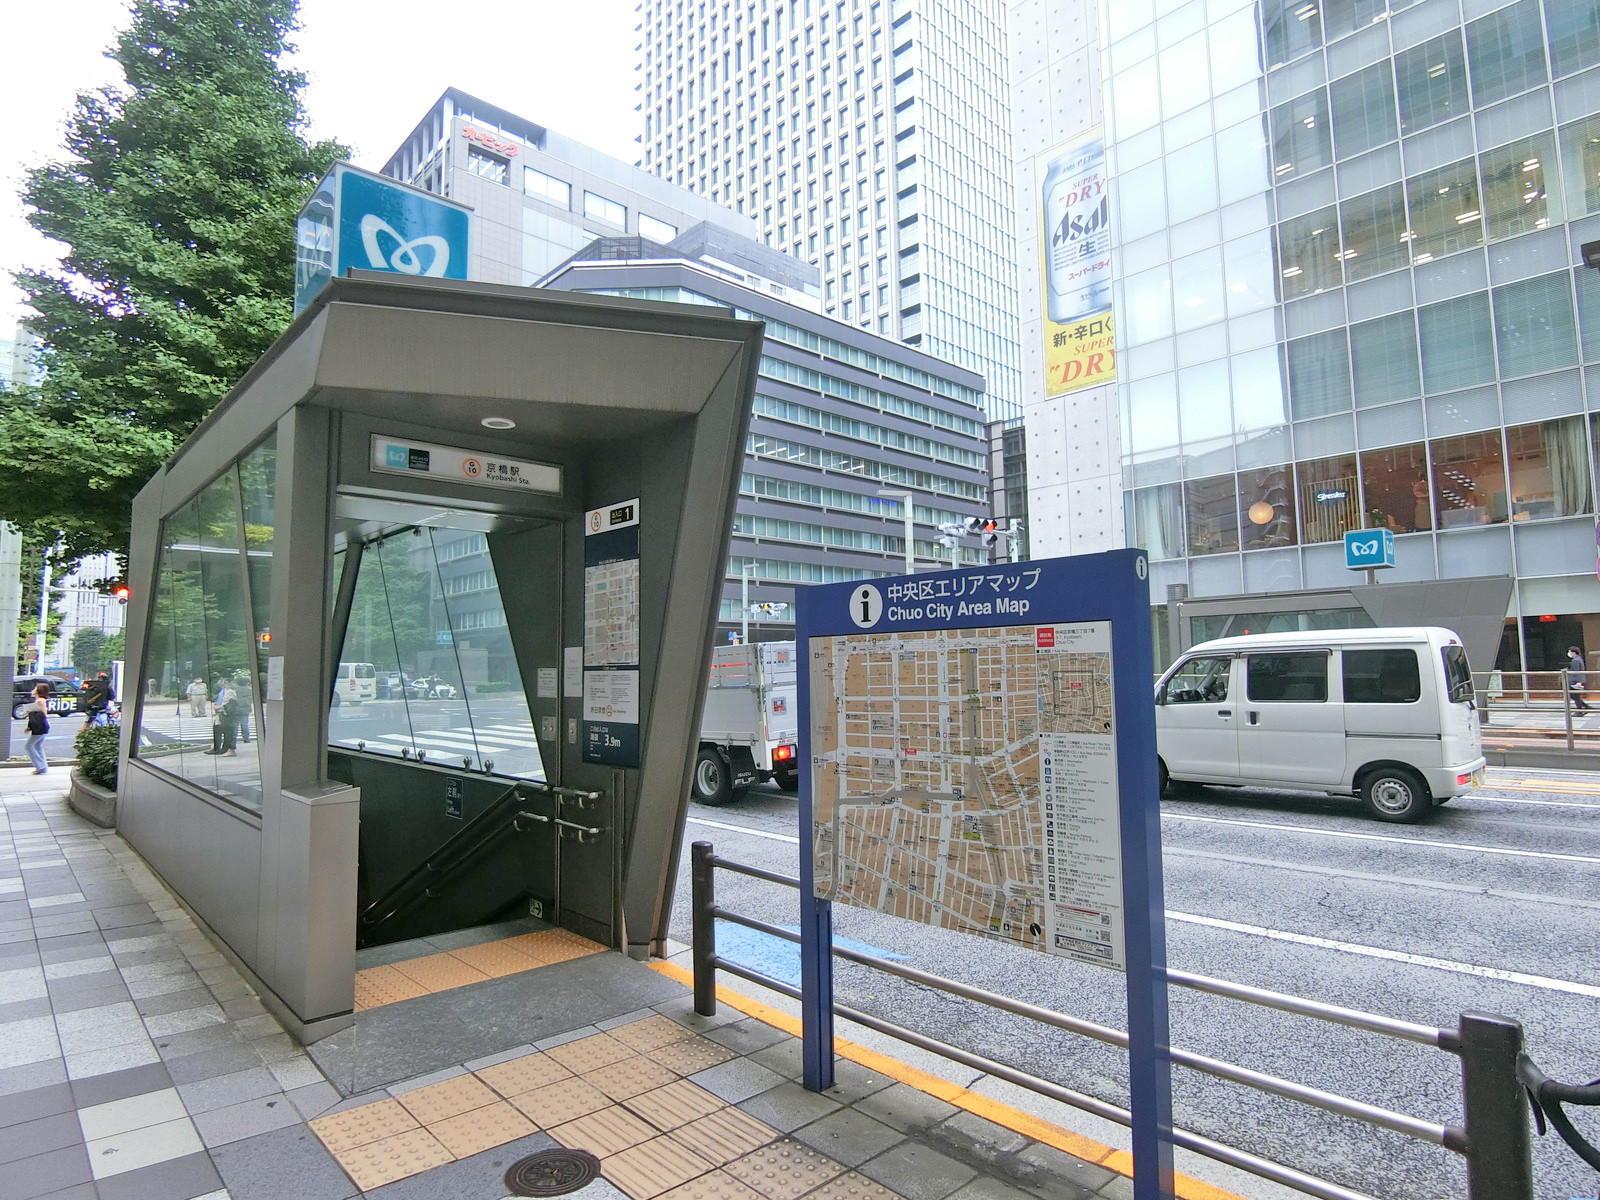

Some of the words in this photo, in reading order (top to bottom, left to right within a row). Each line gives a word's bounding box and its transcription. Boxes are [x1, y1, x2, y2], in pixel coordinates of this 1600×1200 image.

[462, 126, 519, 157] オービック
[1072, 172, 1099, 189] SUPER
[1079, 240, 1097, 258] 生
[1068, 258, 1110, 281] スーパードライ
[1053, 316, 1114, 348] 新・辛口く
[1073, 335, 1114, 356] SUPER
[486, 462, 520, 477] 京橋駅
[486, 473, 518, 483] Kyobashi
[518, 477, 530, 485] Sta.
[625, 507, 631, 521] 1
[887, 567, 1041, 603] 中央区エリアマップ
[887, 606, 923, 621] Chuo
[926, 603, 953, 621] City
[957, 600, 992, 617] Area
[996, 597, 1030, 616] Map
[604, 734, 621, 748] 3.9m
